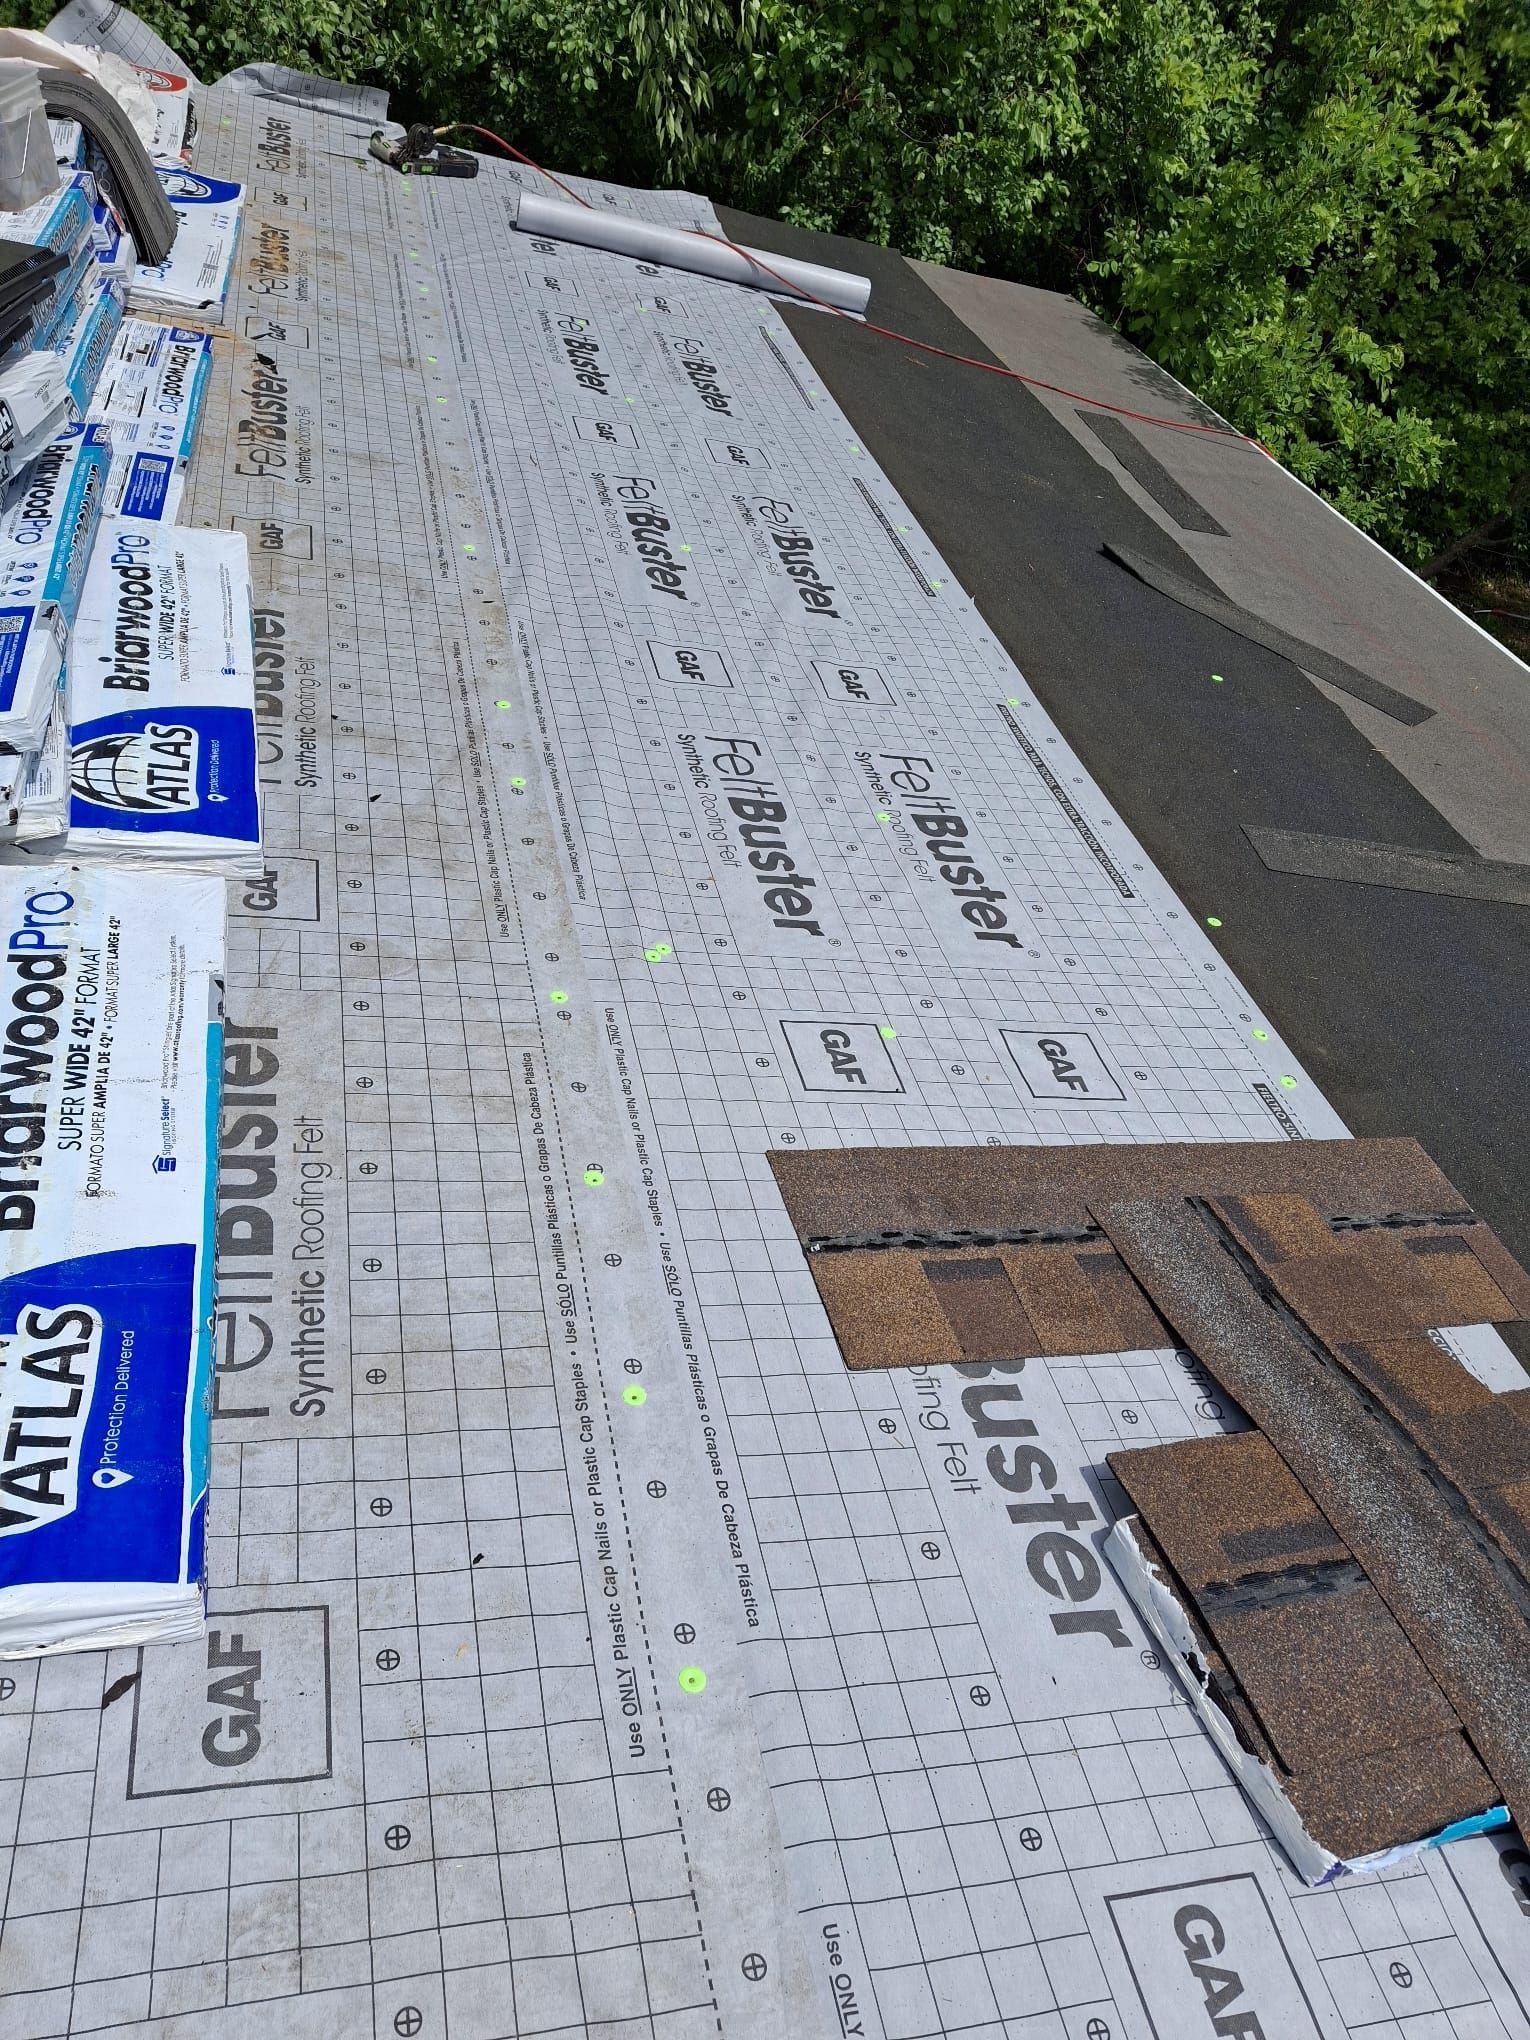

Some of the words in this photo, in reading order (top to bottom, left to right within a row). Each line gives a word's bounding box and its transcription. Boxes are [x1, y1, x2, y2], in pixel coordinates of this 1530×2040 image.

[257, 117, 291, 174] FeltBuster
[248, 223, 289, 298] FeltBuster
[555, 312, 610, 396] FeltBuster
[159, 344, 196, 415] BriarwoodPro
[669, 335, 735, 418] FeltBuster
[235, 369, 288, 480] FeltBuster
[595, 422, 618, 443] GAF
[295, 446, 315, 484] Synthetic
[727, 445, 750, 466] GAF
[589, 472, 612, 508] Synthetic
[730, 494, 757, 527] Synthetic
[261, 523, 284, 550] GAF
[613, 475, 688, 601] FeltBuster
[752, 496, 842, 619] FeltBuster
[157, 565, 174, 594] FORMAT
[98, 534, 150, 692] BriarwoodPro
[159, 612, 175, 635] WIDE
[158, 635, 174, 661] SUPER
[296, 656, 315, 677] Felt
[675, 650, 705, 682] GAF
[296, 678, 321, 724] Roofing
[838, 669, 870, 701] GAF
[208, 739, 220, 765] Delivered
[295, 727, 322, 787] Synthetic
[543, 741, 552, 751] Use
[146, 725, 193, 805] ATLAS
[208, 765, 220, 793] Protection
[472, 767, 482, 778] Use
[476, 785, 488, 806] Staples
[478, 806, 490, 818] Cap
[677, 733, 709, 790] Synthetic
[700, 792, 728, 842] Roofing
[718, 844, 742, 869] Felt
[1053, 788, 1067, 803] CON
[481, 820, 493, 841] Plastic
[855, 751, 892, 806] Synthetic
[884, 809, 918, 857] Roofing
[910, 859, 937, 884] Felt
[485, 840, 494, 848] or
[704, 735, 825, 937] FeltBuster
[879, 753, 1024, 949] FeltBuster
[486, 848, 498, 864] Nails
[488, 865, 501, 879] Cap
[492, 880, 504, 903] Plastic
[111, 915, 121, 931] 42"
[496, 904, 510, 923] ONLY
[499, 923, 510, 938] Use
[109, 932, 120, 960] LARGE
[76, 947, 100, 1006] FORMAT
[107, 960, 119, 990] SUPER
[71, 1006, 96, 1041] 42"
[105, 990, 117, 1023] FORMAT
[604, 1007, 614, 1024] Use
[102, 1033, 113, 1049] 42"
[606, 1024, 622, 1046] ONLY
[65, 1043, 92, 1090] WIDE
[100, 1051, 111, 1064] DE
[525, 1052, 536, 1085] Plástica
[614, 1048, 628, 1077] Plastic
[819, 1028, 867, 1086] GAF
[1037, 1037, 1090, 1095] GAF
[95, 1064, 110, 1109] AMPLIA
[531, 1087, 542, 1119] Cabeza
[621, 1077, 632, 1096] Cap
[1257, 1087, 1287, 1120] FIELTRO
[58, 1092, 82, 1151] SUPER
[91, 1109, 106, 1142] SUPER
[160, 1097, 170, 1121] Select
[626, 1097, 638, 1120] Nails
[161, 1122, 174, 1156] Signature
[294, 1115, 325, 1154] Felt
[533, 1121, 544, 1135] De
[631, 1121, 641, 1132] or
[539, 1137, 550, 1172] Grapas
[634, 1134, 649, 1166] Plastic
[86, 1142, 104, 1198] FORMATO
[642, 1169, 654, 1187] Cap
[292, 1162, 332, 1260] Roofing
[544, 1184, 559, 1231] Plásticas
[647, 1189, 663, 1228] Staples
[552, 1232, 568, 1280] Puntillas
[660, 1242, 672, 1263] Use
[662, 1264, 683, 1297] SÓLO
[555, 1284, 577, 1317] SÓLO
[565, 1321, 577, 1344] Use
[673, 1300, 692, 1350] Puntillas
[290, 1270, 334, 1417] Synthetic
[100, 1393, 128, 1464] Protection
[115, 1329, 135, 1389] Delivered
[571, 1363, 588, 1412] Staples
[685, 1354, 708, 1411] Plásticas
[0, 1310, 93, 1507] ATLAS
[701, 1414, 711, 1422] o
[580, 1415, 597, 1443] Cap
[703, 1426, 723, 1478] Grapas
[938, 1442, 982, 1496] Felt
[586, 1444, 602, 1496] Plastic
[716, 1480, 729, 1501] De
[594, 1501, 608, 1518] or
[598, 1518, 613, 1560] Nails
[721, 1503, 742, 1559] Cabeza
[603, 1562, 621, 1597] Cap
[737, 1563, 760, 1628] Plástica
[609, 1604, 629, 1661] Plastic
[202, 1630, 262, 1767] GAF
[620, 1667, 642, 1716] ONLY
[630, 1719, 645, 1757] Use
[820, 1922, 845, 1969] Use
[1173, 1904, 1268, 2040] GAF
[830, 1971, 866, 2038] ONLY
